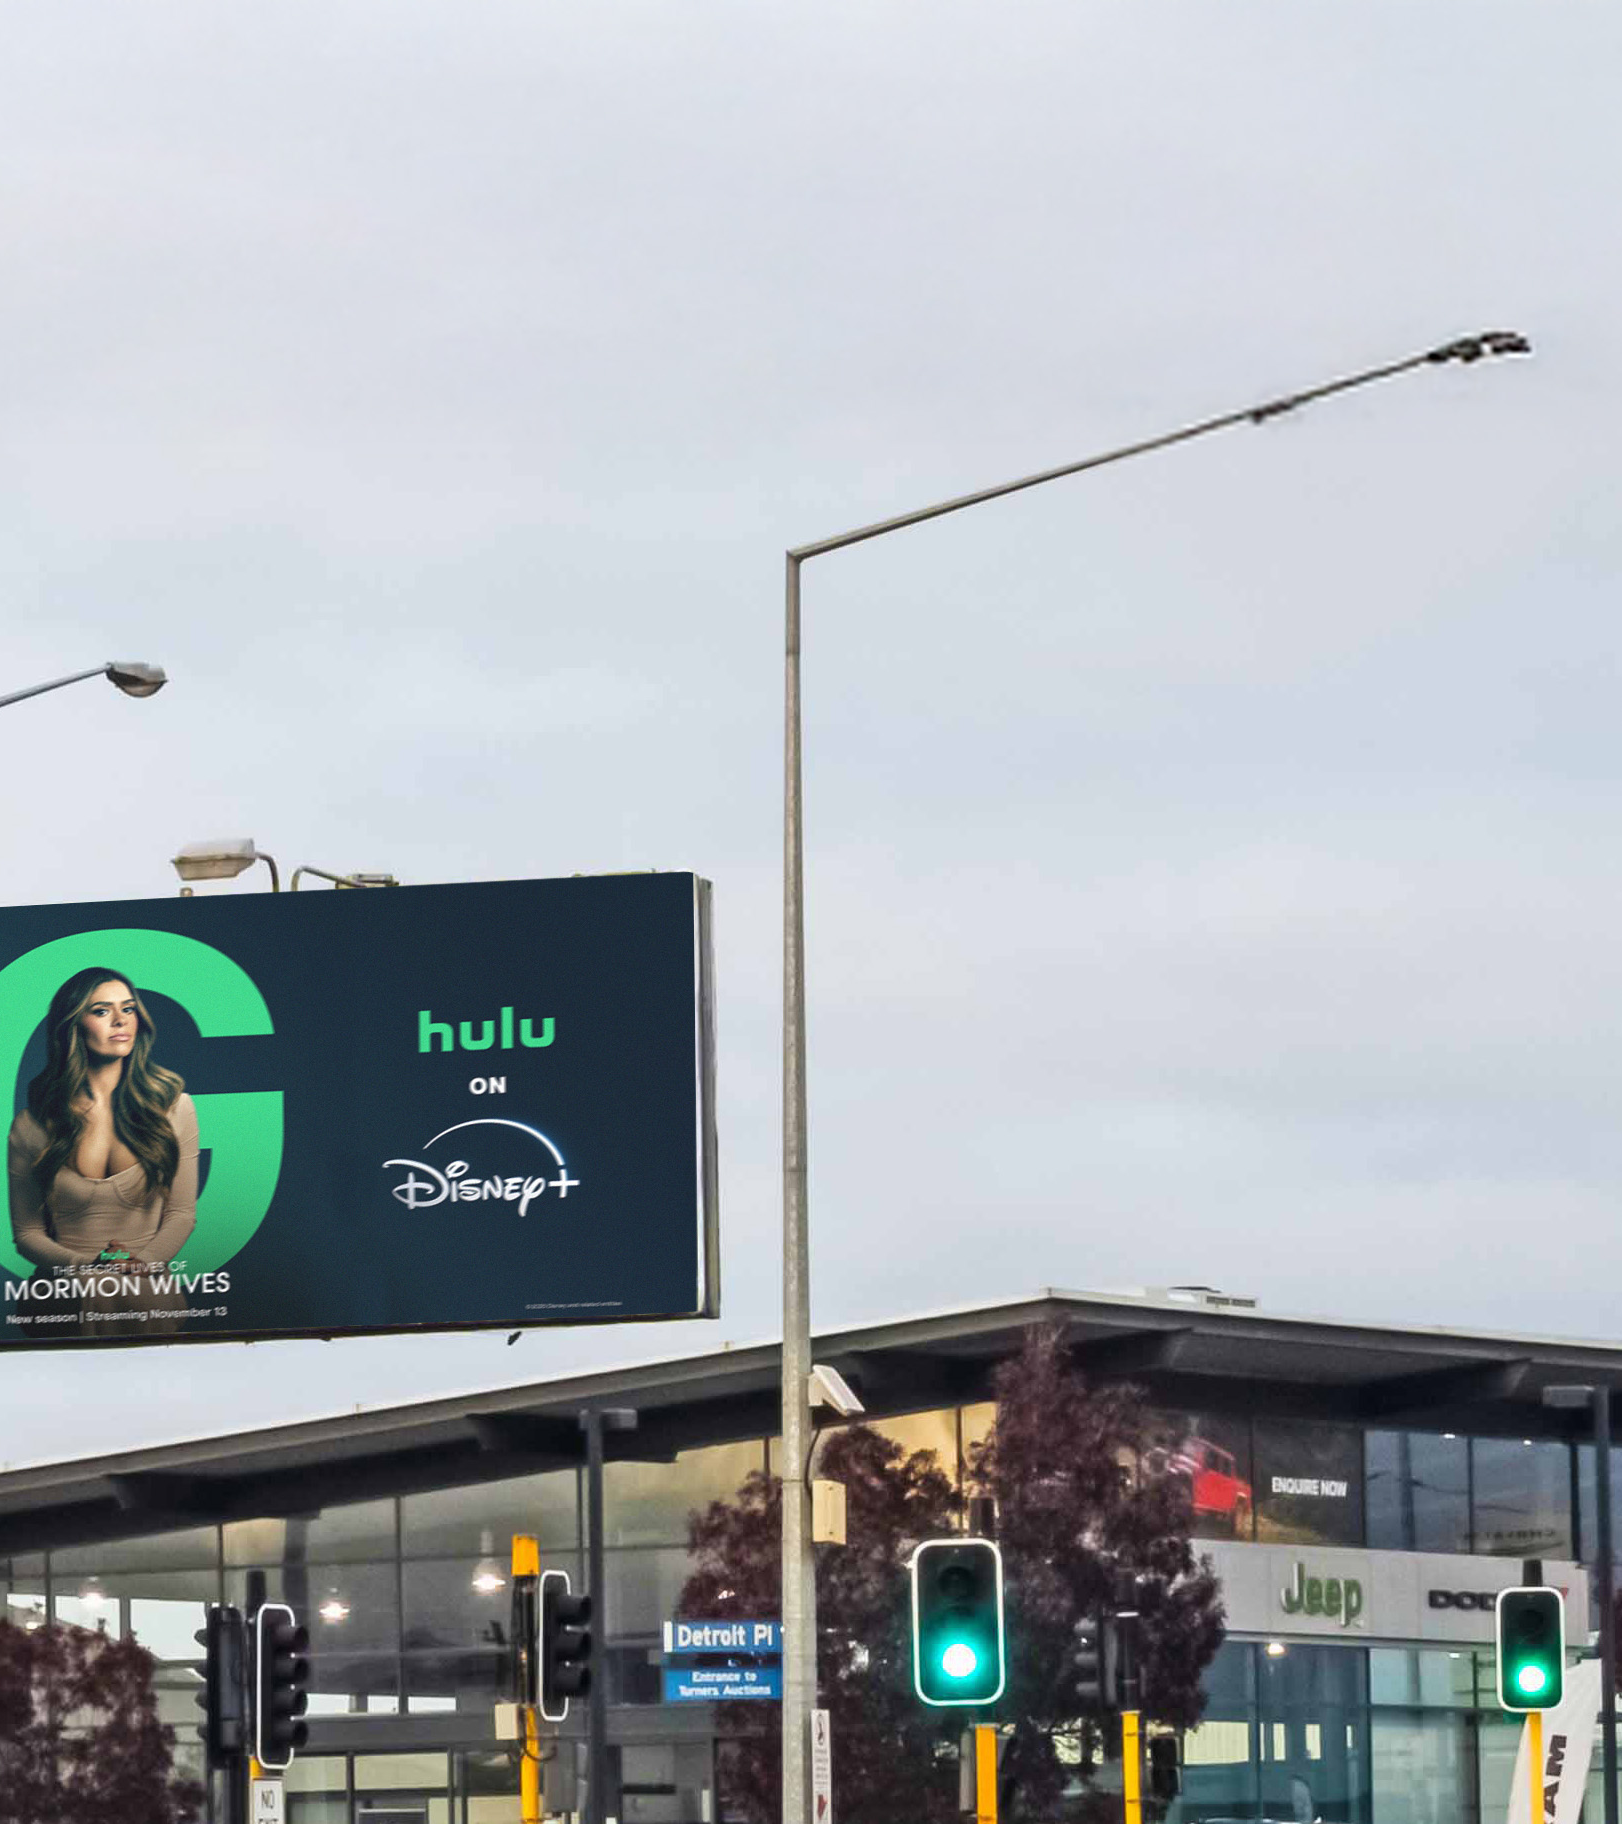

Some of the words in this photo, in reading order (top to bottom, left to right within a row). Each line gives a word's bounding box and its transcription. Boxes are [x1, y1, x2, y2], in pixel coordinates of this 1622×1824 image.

[418, 1006, 555, 1053] hulu
[469, 1076, 506, 1095] ON
[382, 1159, 580, 1217] Disney+
[100, 1249, 130, 1260] hulu
[52, 1265, 75, 1276] THE
[79, 1263, 126, 1275] SECRET
[130, 1261, 166, 1273] LIVES
[168, 1261, 187, 1272] OF
[4, 1275, 141, 1302] MORMON
[149, 1271, 231, 1295] WIVES
[6, 1314, 33, 1324] New
[35, 1313, 77, 1324] season
[85, 1308, 148, 1322] Streaming
[149, 1307, 211, 1319] November
[213, 1306, 228, 1317] 13
[1271, 1476, 1320, 1495] ENQUIRE
[1321, 1479, 1347, 1497] NOW
[1280, 1561, 1363, 1628] Jeep
[1428, 1589, 1497, 1611] DOD
[677, 1624, 746, 1647] Detroit
[753, 1624, 773, 1646] Pl
[692, 1671, 740, 1682] Entrance
[744, 1672, 757, 1681] to
[723, 1684, 771, 1695] Auctions
[261, 1789, 275, 1809] NO
